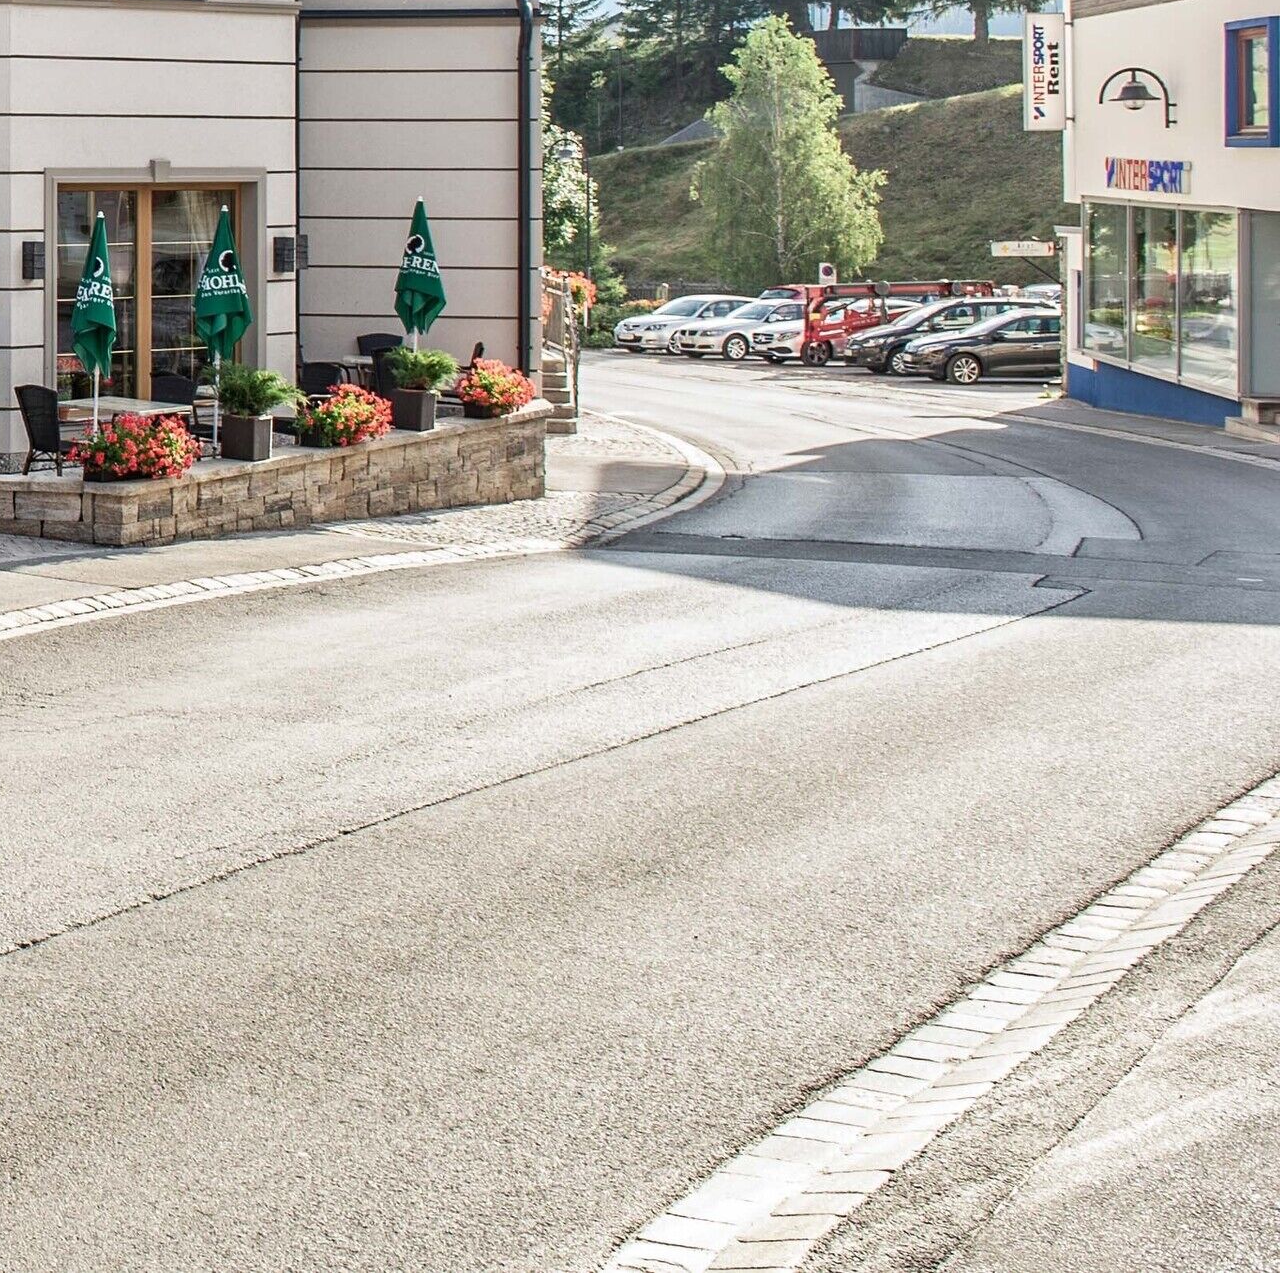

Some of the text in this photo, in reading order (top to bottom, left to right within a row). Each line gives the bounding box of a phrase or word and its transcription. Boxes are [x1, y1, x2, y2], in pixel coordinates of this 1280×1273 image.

[1033, 24, 1045, 105] INTERSPORT
[1047, 42, 1060, 95] Rent
[1115, 158, 1184, 193] INTERSPORT
